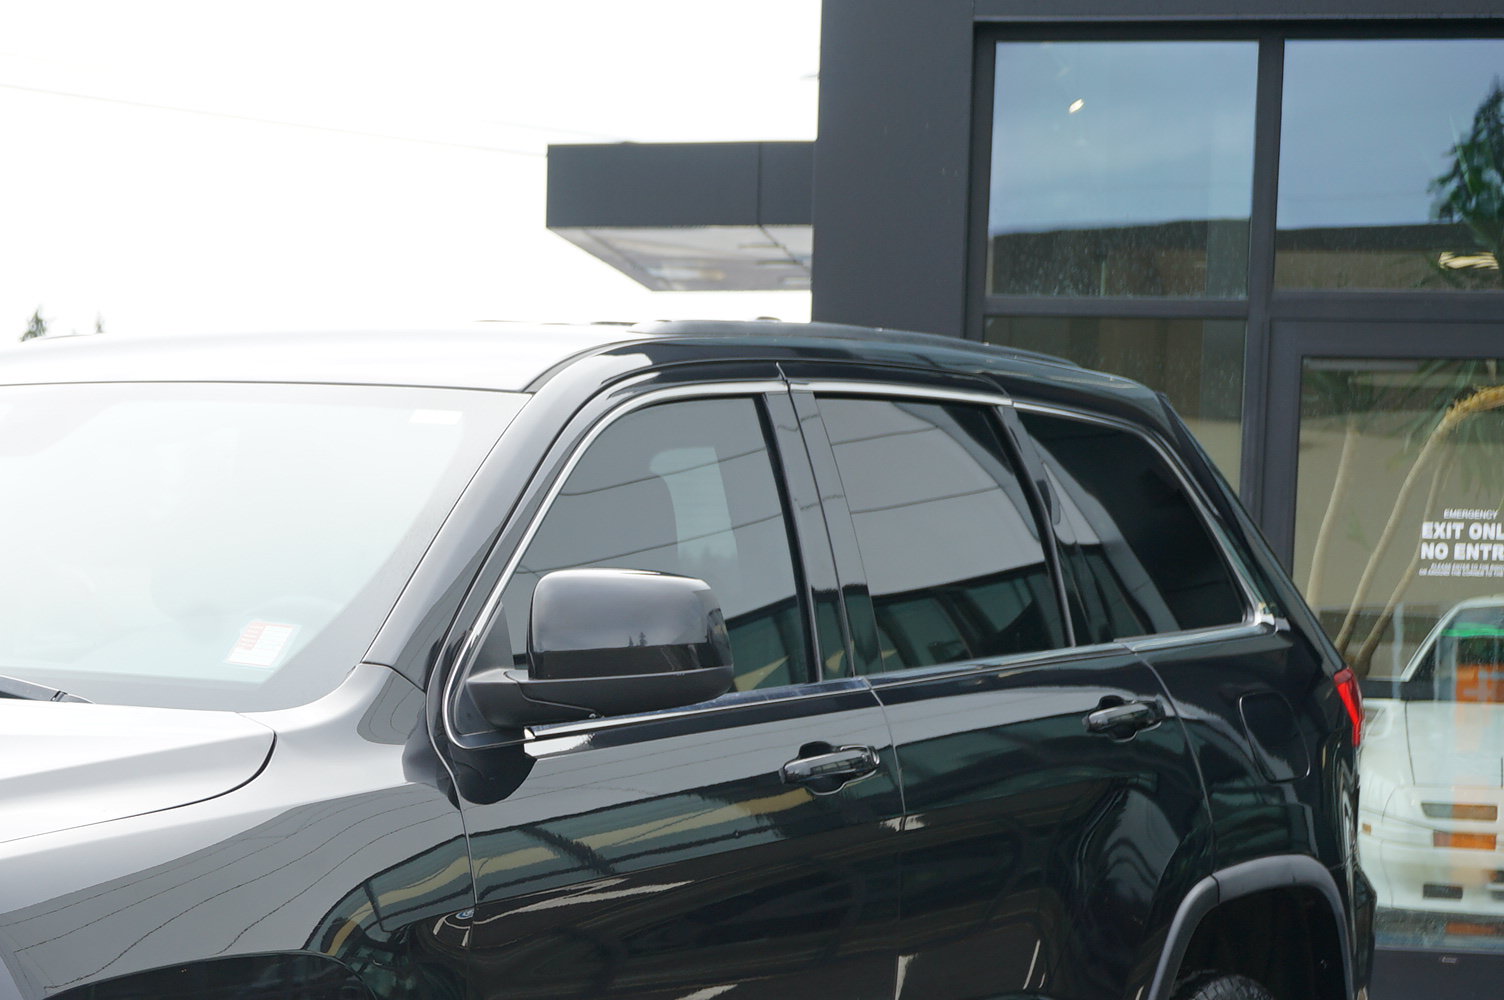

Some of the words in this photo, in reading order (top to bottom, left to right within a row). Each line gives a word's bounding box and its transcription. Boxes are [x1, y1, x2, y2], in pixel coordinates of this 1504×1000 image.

[1443, 508, 1497, 520] EMERGENCY
[1422, 521, 1464, 539] EXIT
[1469, 522, 1504, 540] ONL
[1421, 542, 1448, 560] NO
[1454, 543, 1504, 560] ENTR
